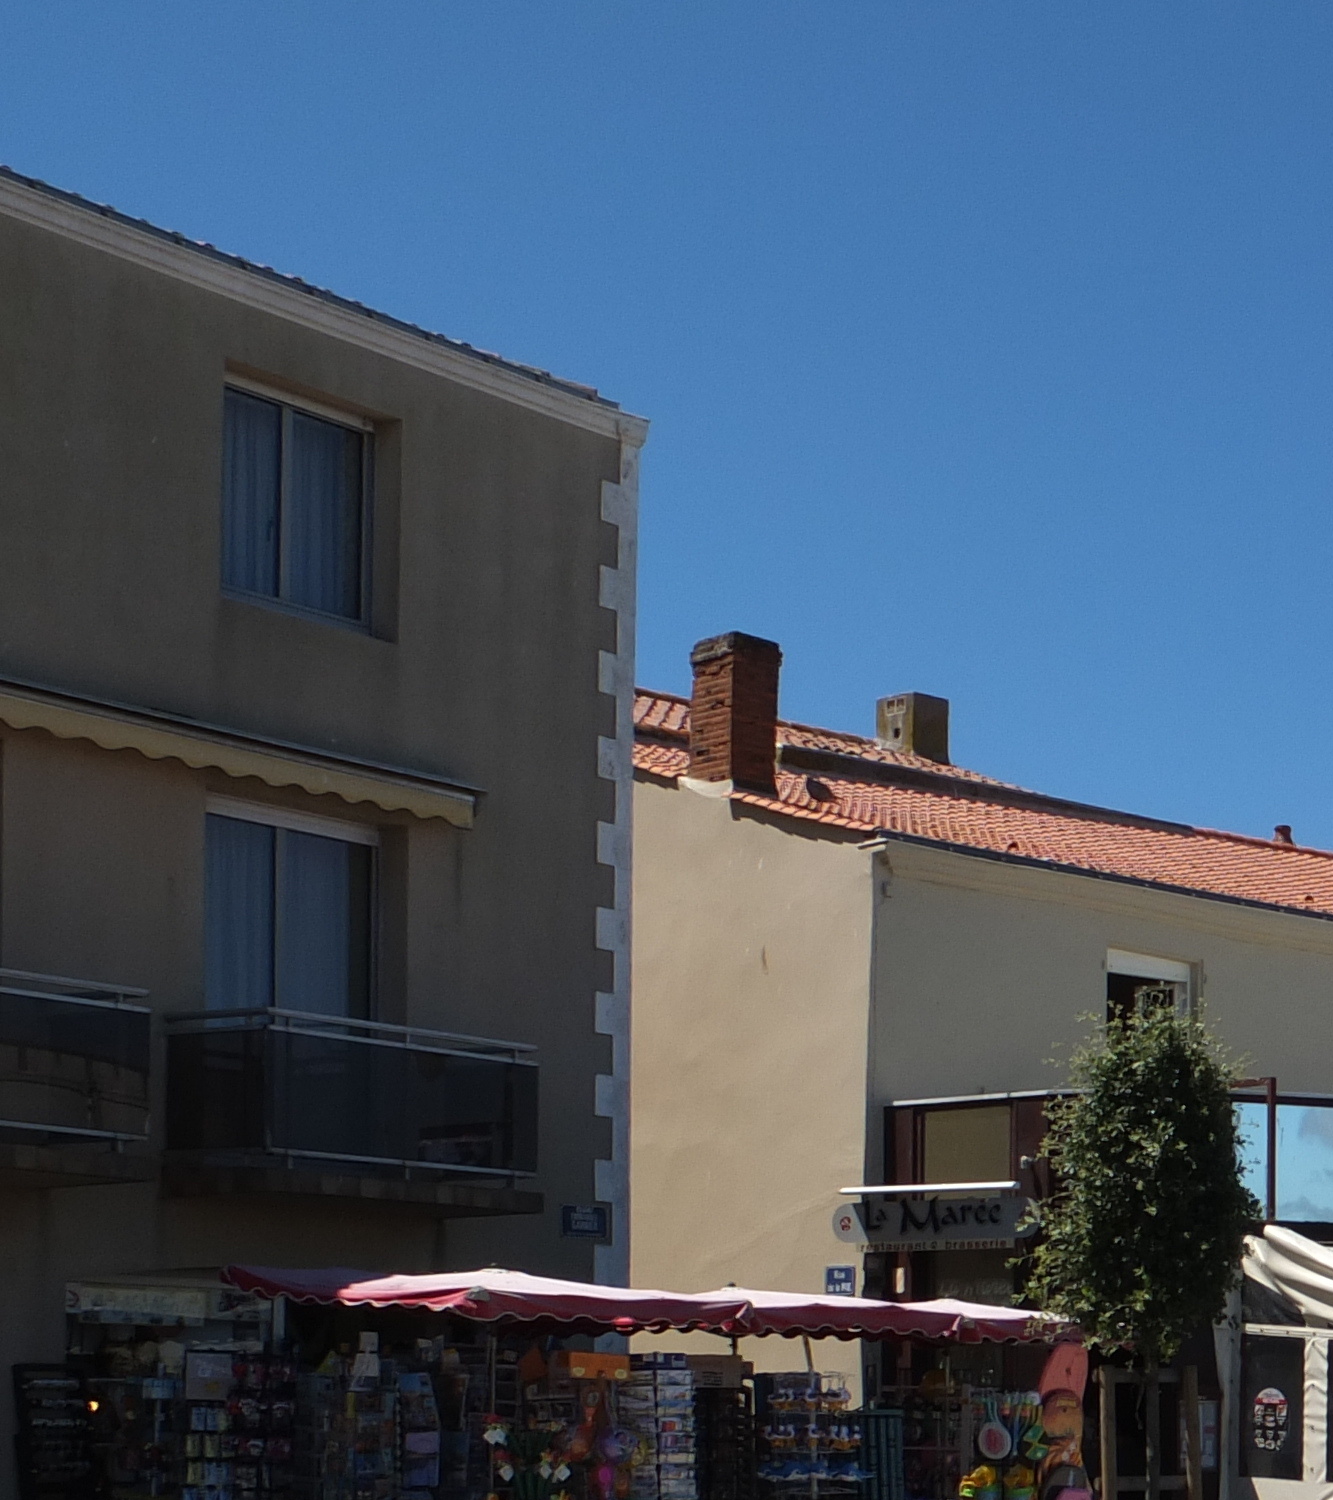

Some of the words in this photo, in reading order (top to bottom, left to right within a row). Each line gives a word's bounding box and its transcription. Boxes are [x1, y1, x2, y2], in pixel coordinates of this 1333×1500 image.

[864, 1199, 887, 1231] La
[901, 1195, 1001, 1234] Marée
[860, 1242, 927, 1252] restaurant
[945, 1237, 1008, 1251] brasserie
